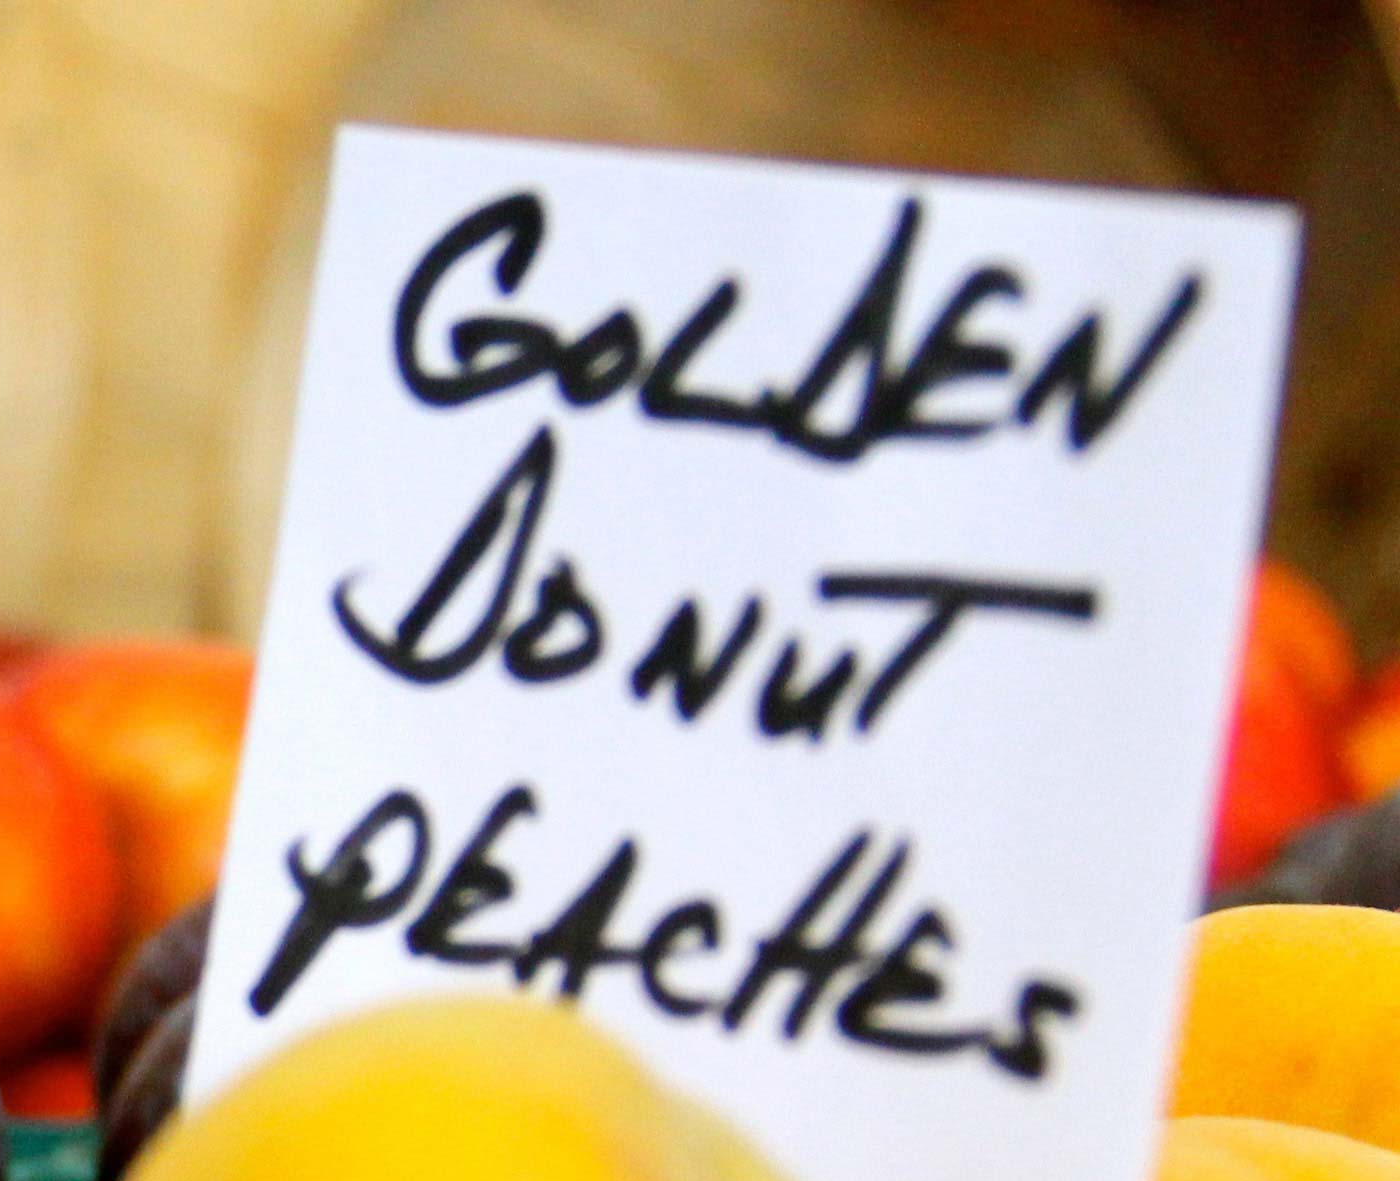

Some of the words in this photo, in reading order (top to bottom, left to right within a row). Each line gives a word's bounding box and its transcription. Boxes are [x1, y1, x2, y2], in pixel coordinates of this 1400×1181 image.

[392, 190, 1202, 465] GOLDEN
[330, 422, 1101, 742] DONUT
[246, 784, 1082, 1082] PEACHES
